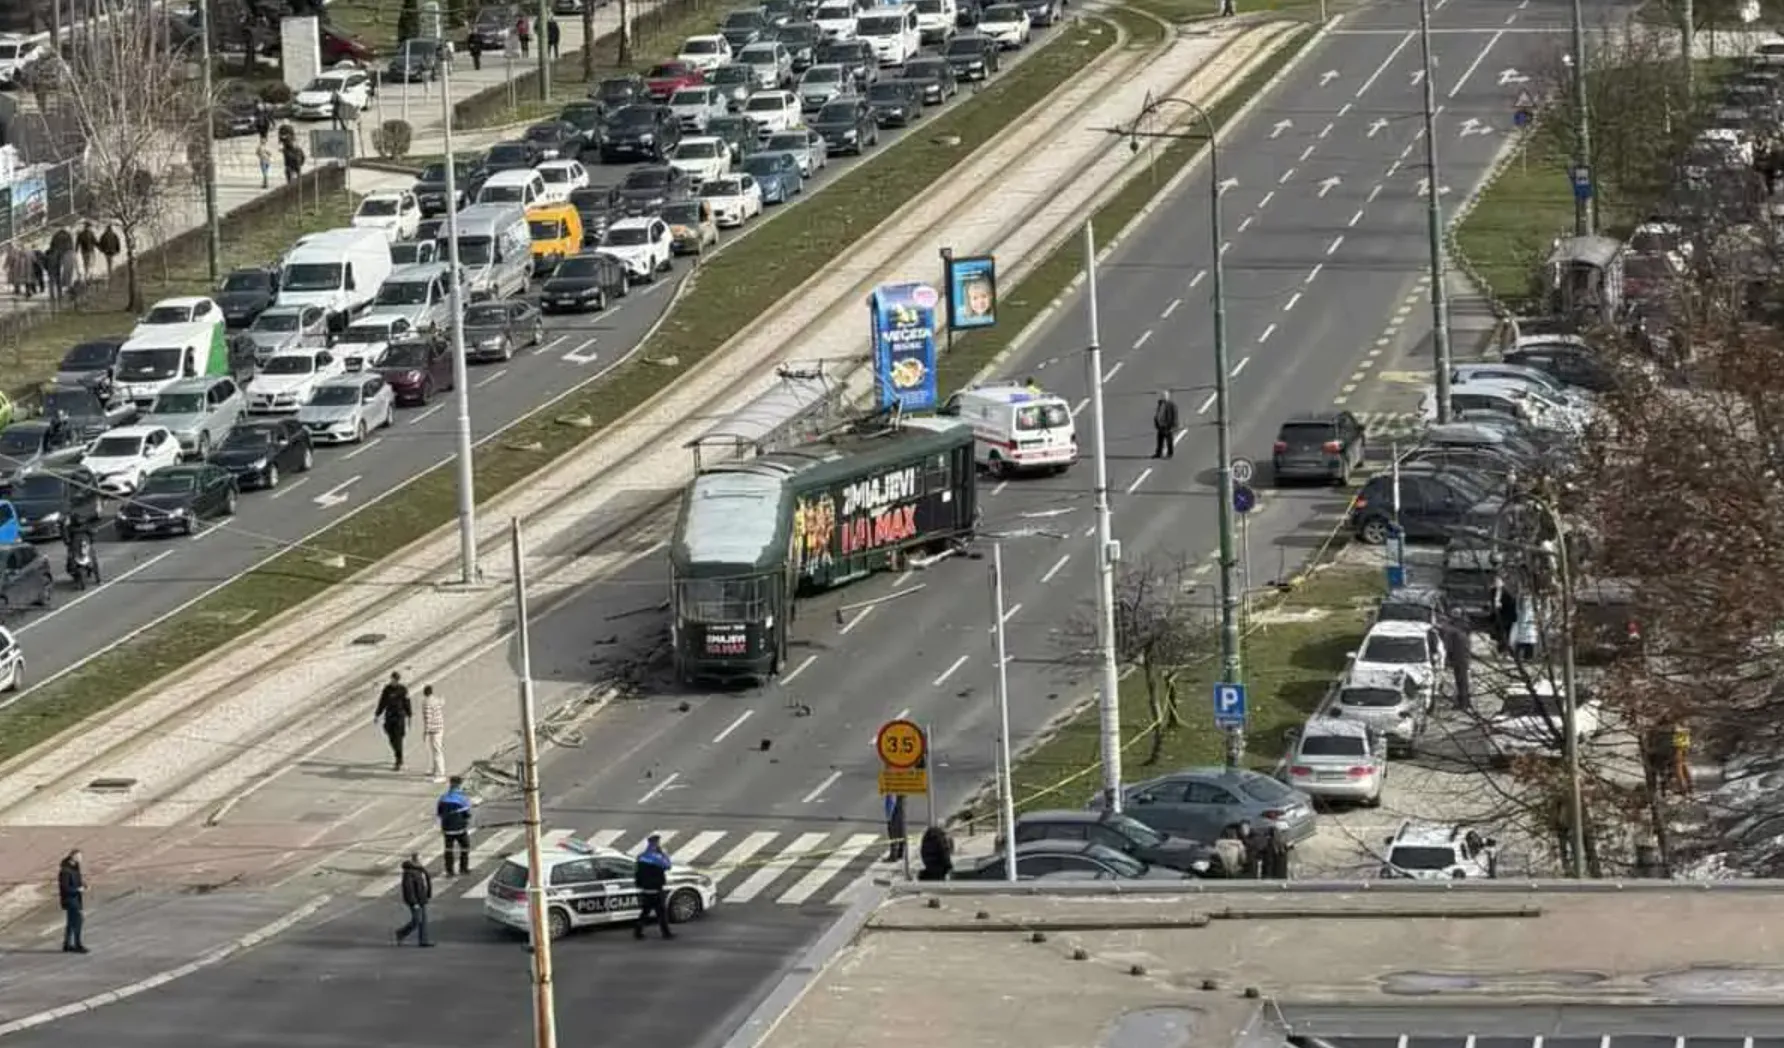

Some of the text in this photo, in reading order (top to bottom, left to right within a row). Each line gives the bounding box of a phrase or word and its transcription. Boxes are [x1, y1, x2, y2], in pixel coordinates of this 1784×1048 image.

[875, 504, 918, 546] MAX
[1222, 687, 1239, 711] P
[577, 895, 639, 911] POLICIJA
